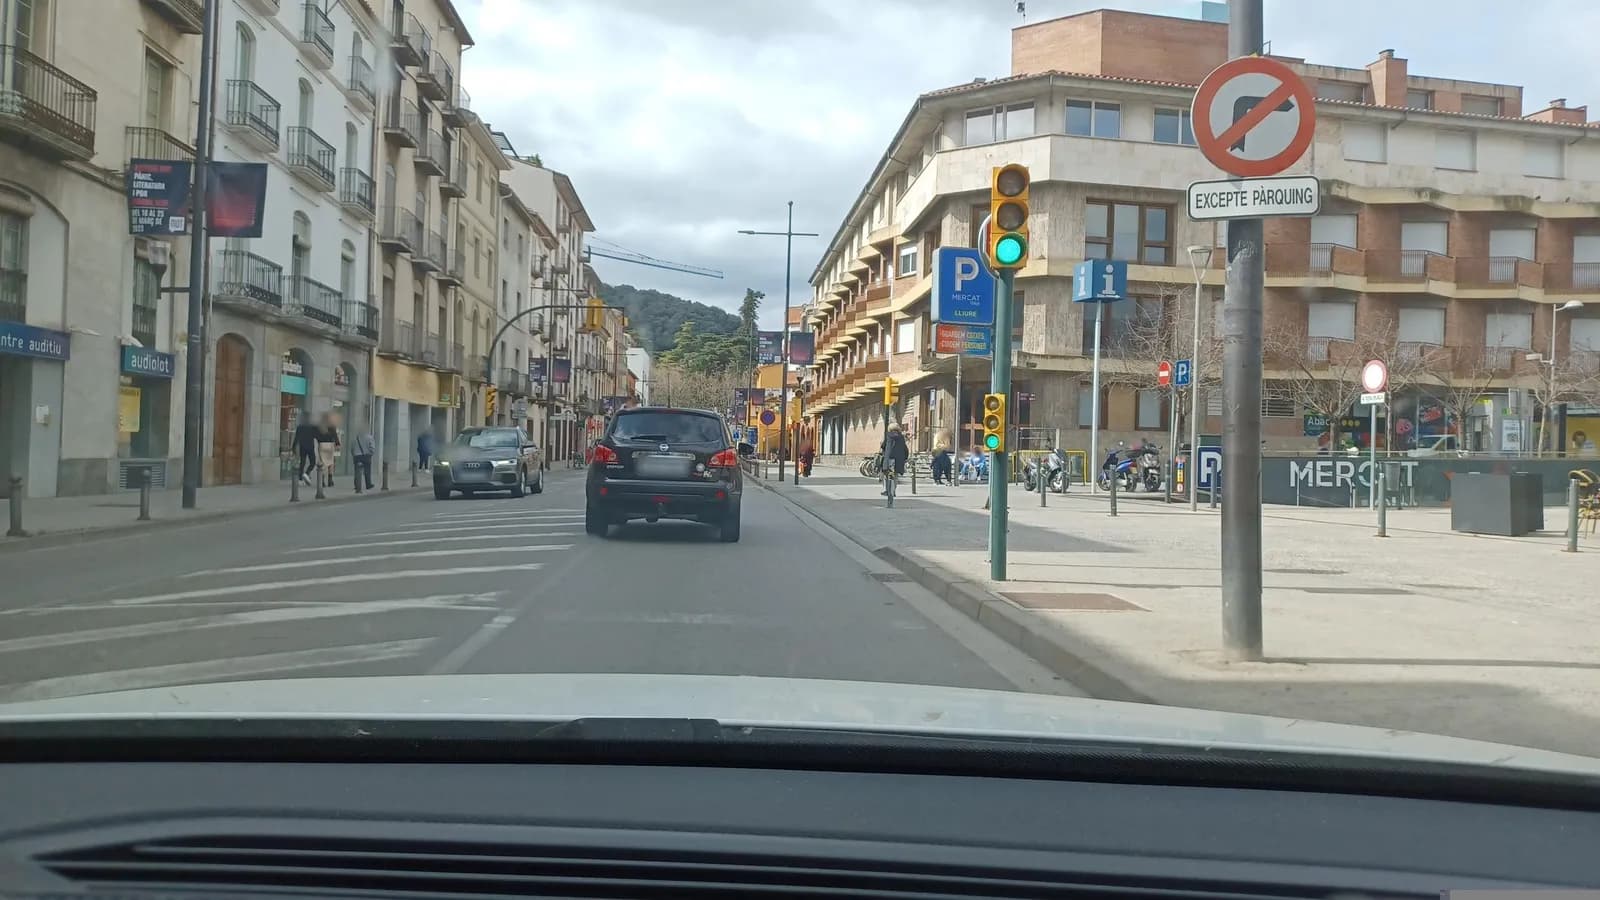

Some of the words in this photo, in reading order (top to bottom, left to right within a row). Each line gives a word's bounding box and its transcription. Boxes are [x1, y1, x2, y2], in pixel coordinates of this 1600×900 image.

[1195, 190, 1248, 209] EXCEPTE
[1253, 185, 1313, 206] PÀRQUING
[954, 256, 980, 292] P
[954, 310, 977, 318] LLIURE
[0, 333, 24, 349] ntre
[29, 339, 62, 356] auditiu
[131, 353, 170, 373] audiolot
[1178, 363, 1188, 382] P
[1289, 460, 1419, 487] MERCT
